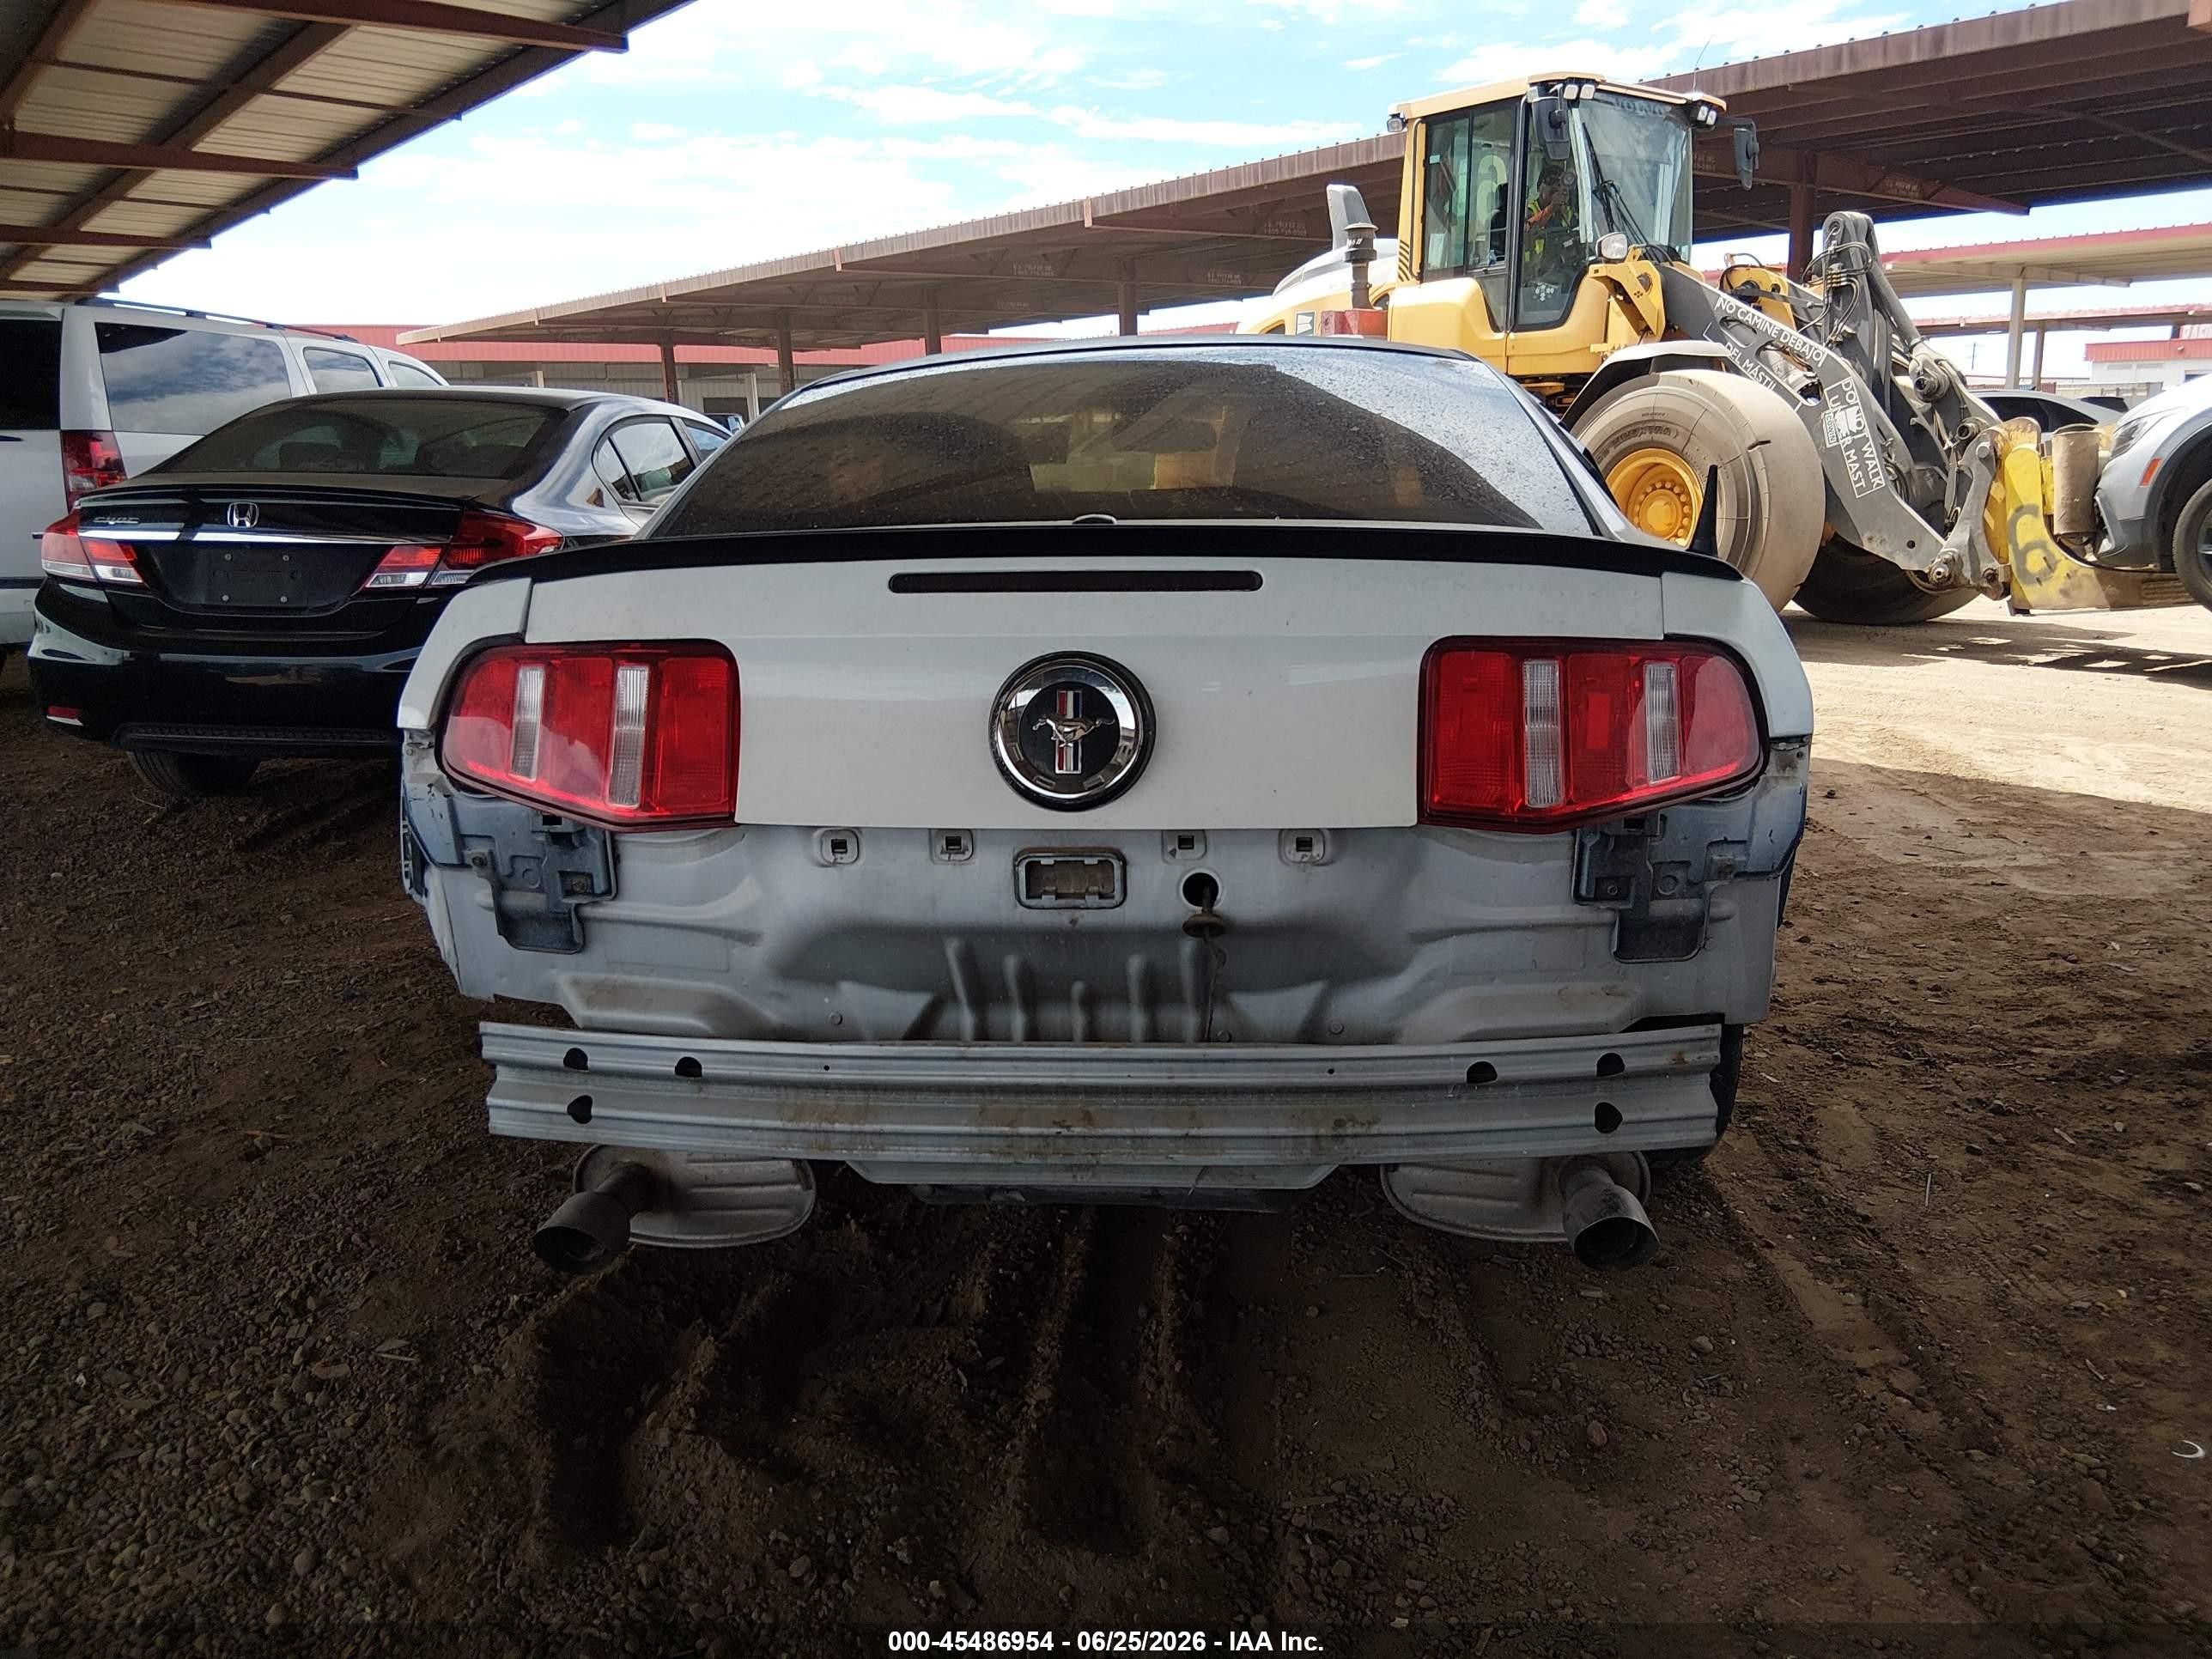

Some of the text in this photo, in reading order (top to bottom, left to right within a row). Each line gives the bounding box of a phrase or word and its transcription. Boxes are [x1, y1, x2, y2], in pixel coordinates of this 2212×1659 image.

[1717, 296, 1825, 362] NO CAMINE DEBAJO
[1724, 342, 1743, 365] DEL
[1830, 394, 1865, 489] UNER MAST
[1842, 378, 1856, 404] DO
[1862, 441, 1882, 489] WALK
[2007, 503, 2057, 586] 6
